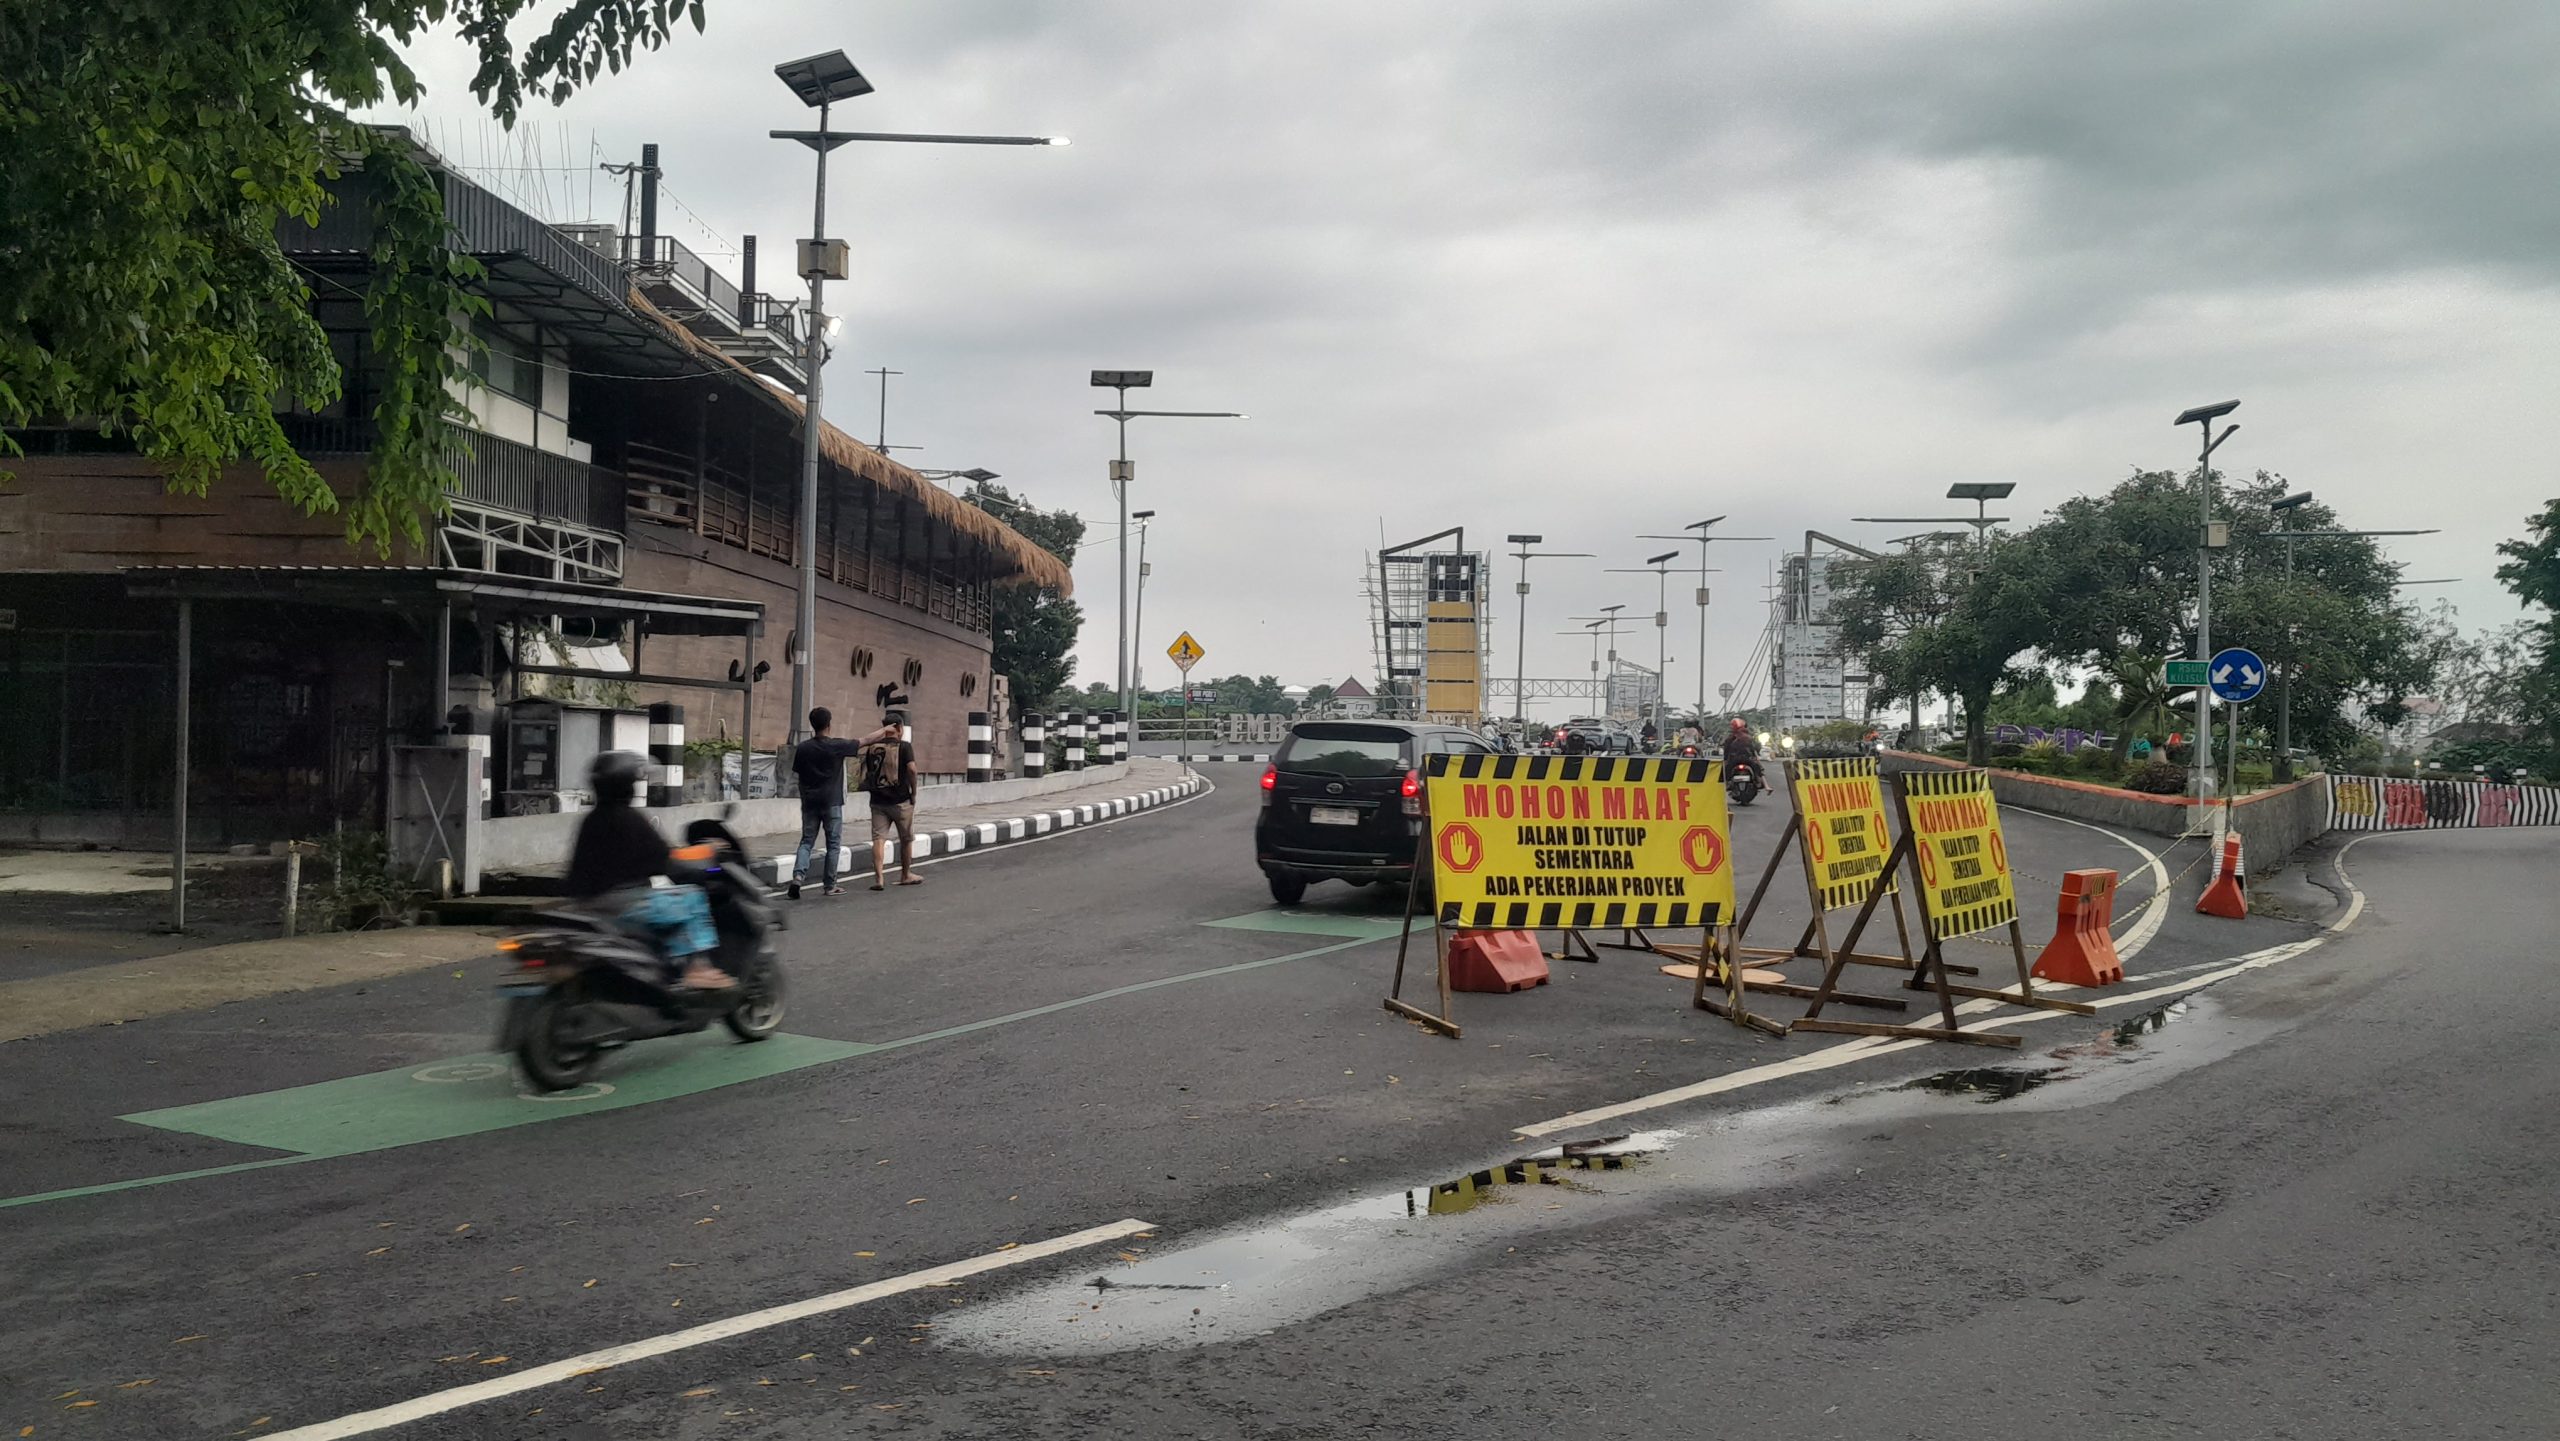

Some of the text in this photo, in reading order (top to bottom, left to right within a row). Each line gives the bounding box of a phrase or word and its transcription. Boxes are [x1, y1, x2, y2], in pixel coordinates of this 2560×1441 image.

[2170, 675, 2208, 683] KILISU
[2179, 664, 2206, 673] RSUD
[1463, 784, 1691, 821] MOHON MAAF
[1807, 782, 1873, 813] MOHON MAAF
[1958, 797, 1988, 829] MAAF
[1517, 825, 1647, 847] JALAN DI TUTUP
[1535, 849, 1634, 870] SEMENTARA
[1485, 875, 1686, 897] ADA PEKERJAAN PROYEK
